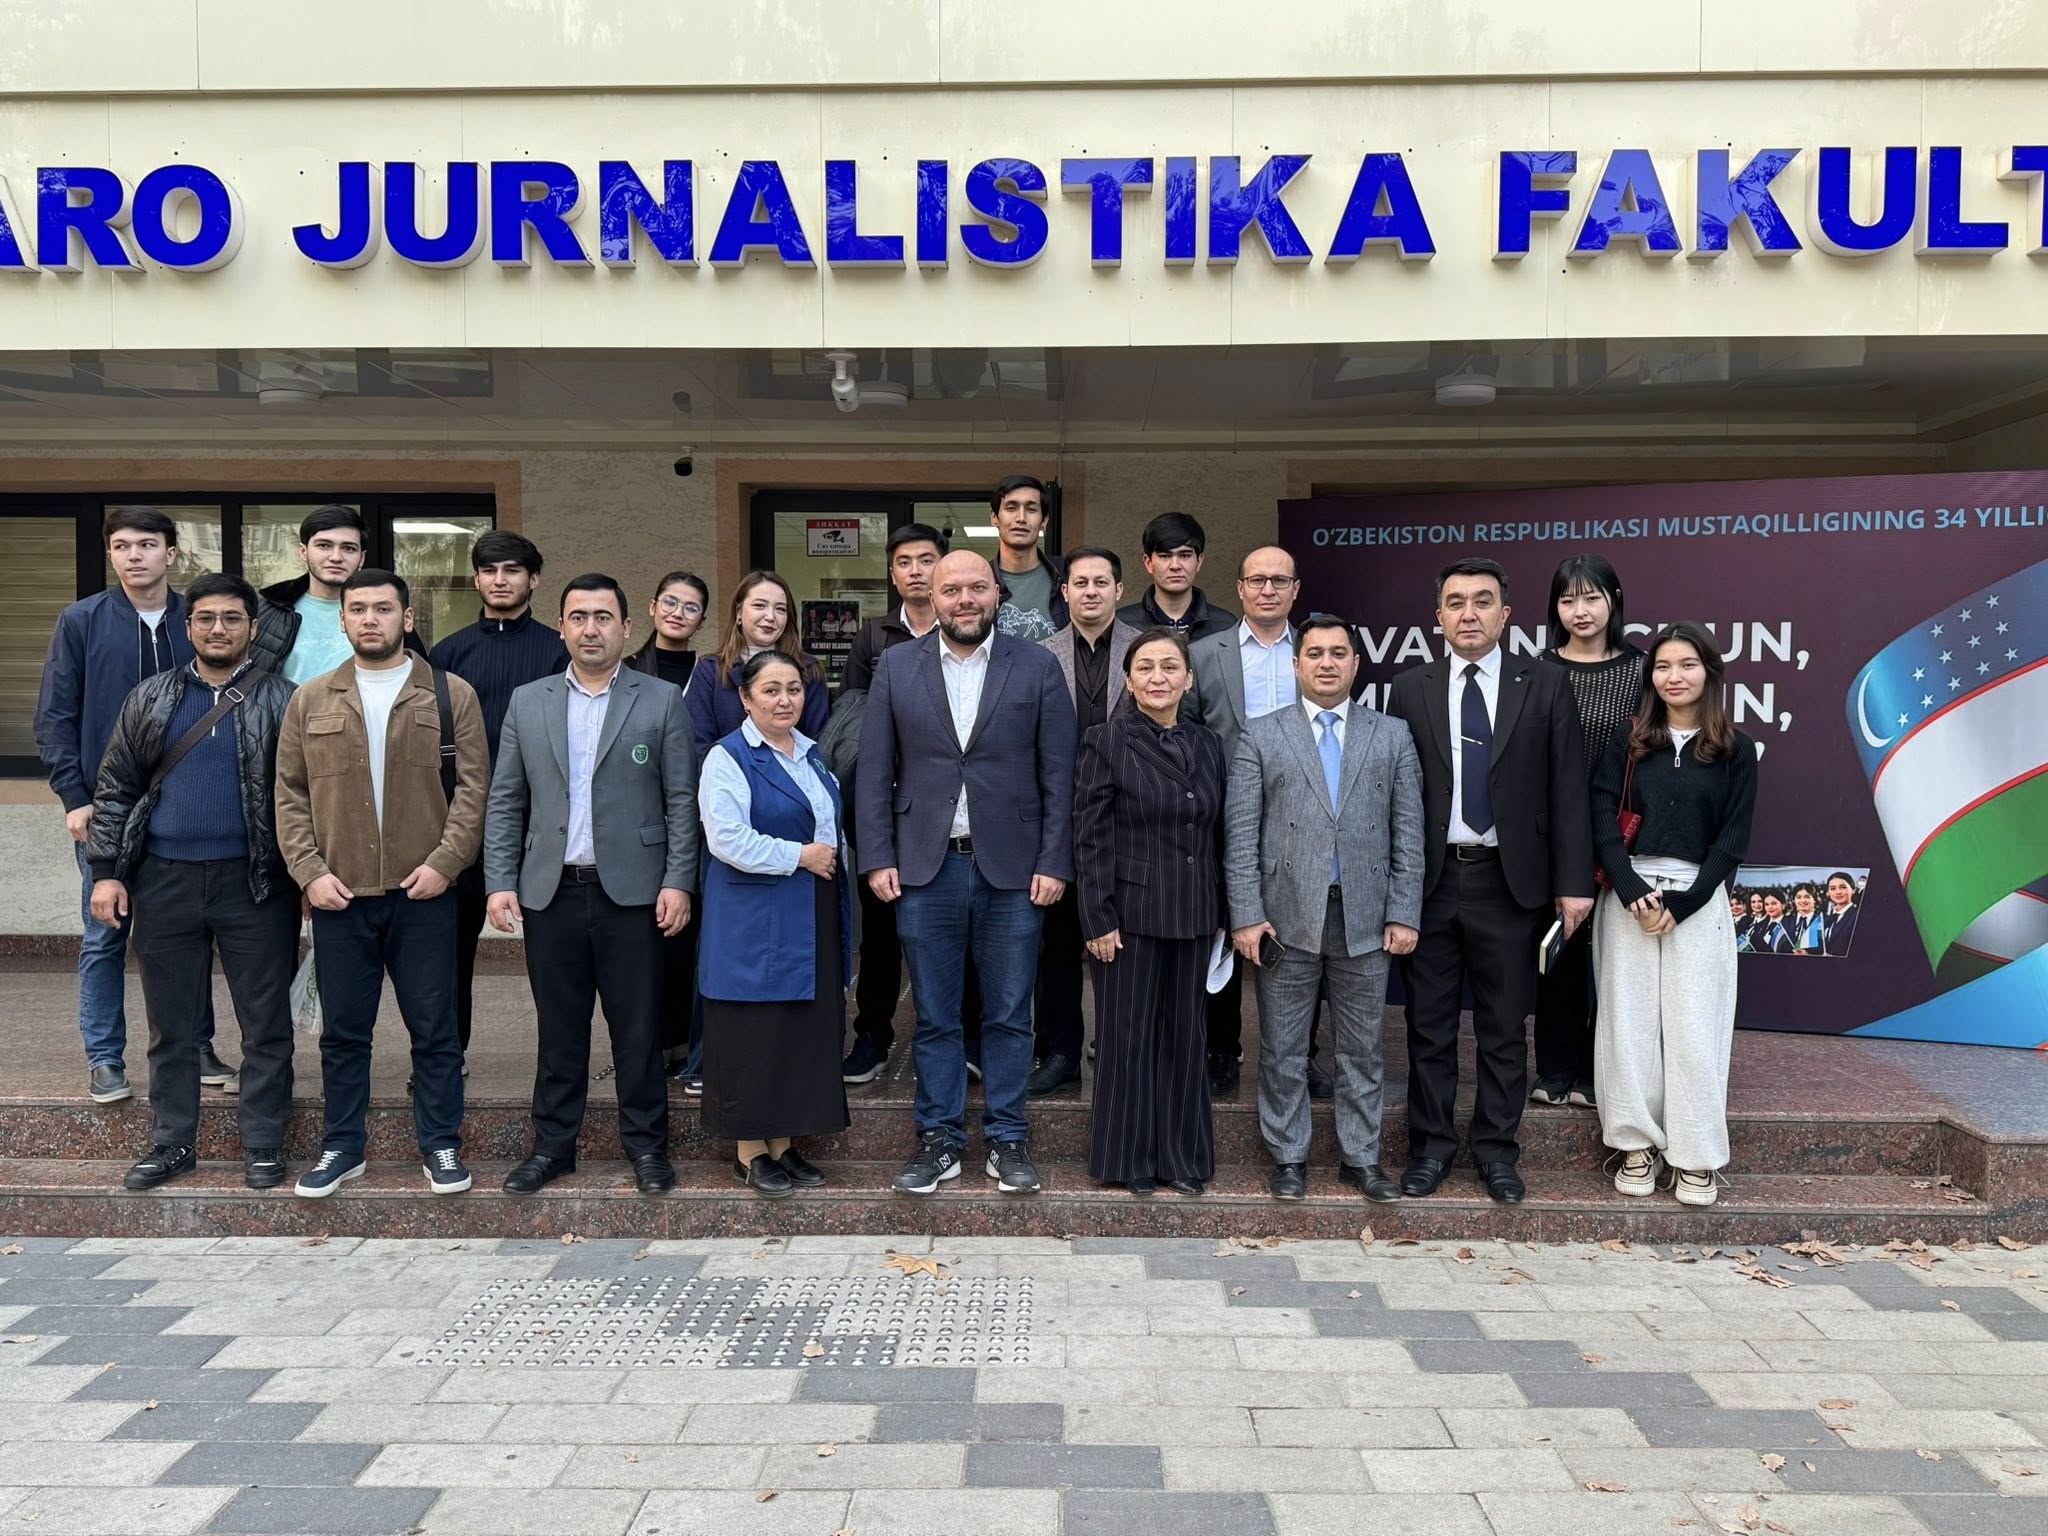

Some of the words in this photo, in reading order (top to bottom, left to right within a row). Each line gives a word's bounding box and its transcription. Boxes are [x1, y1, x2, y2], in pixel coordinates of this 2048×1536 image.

[0, 164, 234, 270] RO
[293, 154, 1437, 268] JURNALISTIKA
[1473, 519, 1649, 543] RESPUBLIKASI
[1658, 508, 1925, 537] MUSTAQILLIGINING
[1934, 507, 1967, 529] 34
[1974, 505, 2048, 528] YILLI
